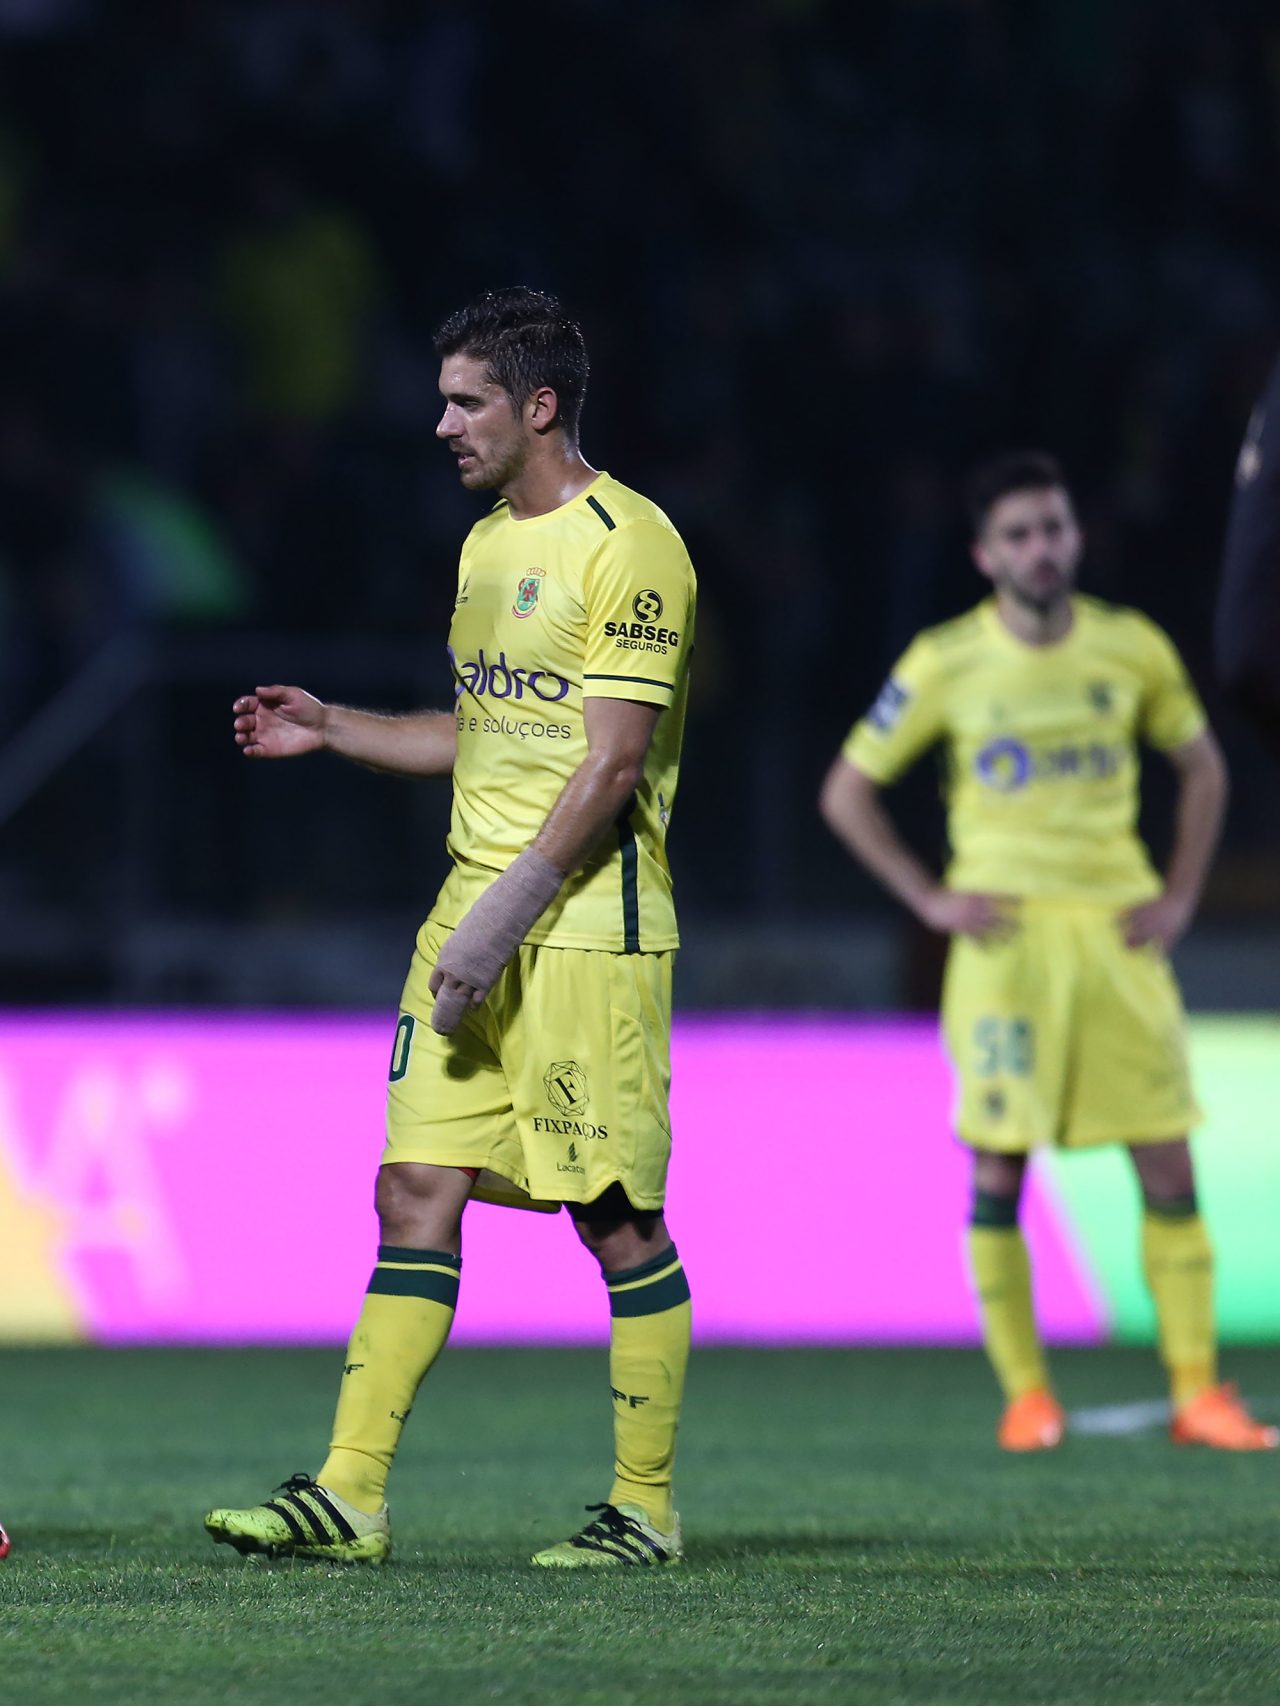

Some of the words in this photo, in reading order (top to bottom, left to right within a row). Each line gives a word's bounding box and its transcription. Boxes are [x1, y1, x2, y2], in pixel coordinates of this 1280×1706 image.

[604, 621, 679, 647] SABSEG
[615, 638, 668, 655] SEGUROS
[461, 649, 569, 702] aldro
[469, 718, 477, 731] e
